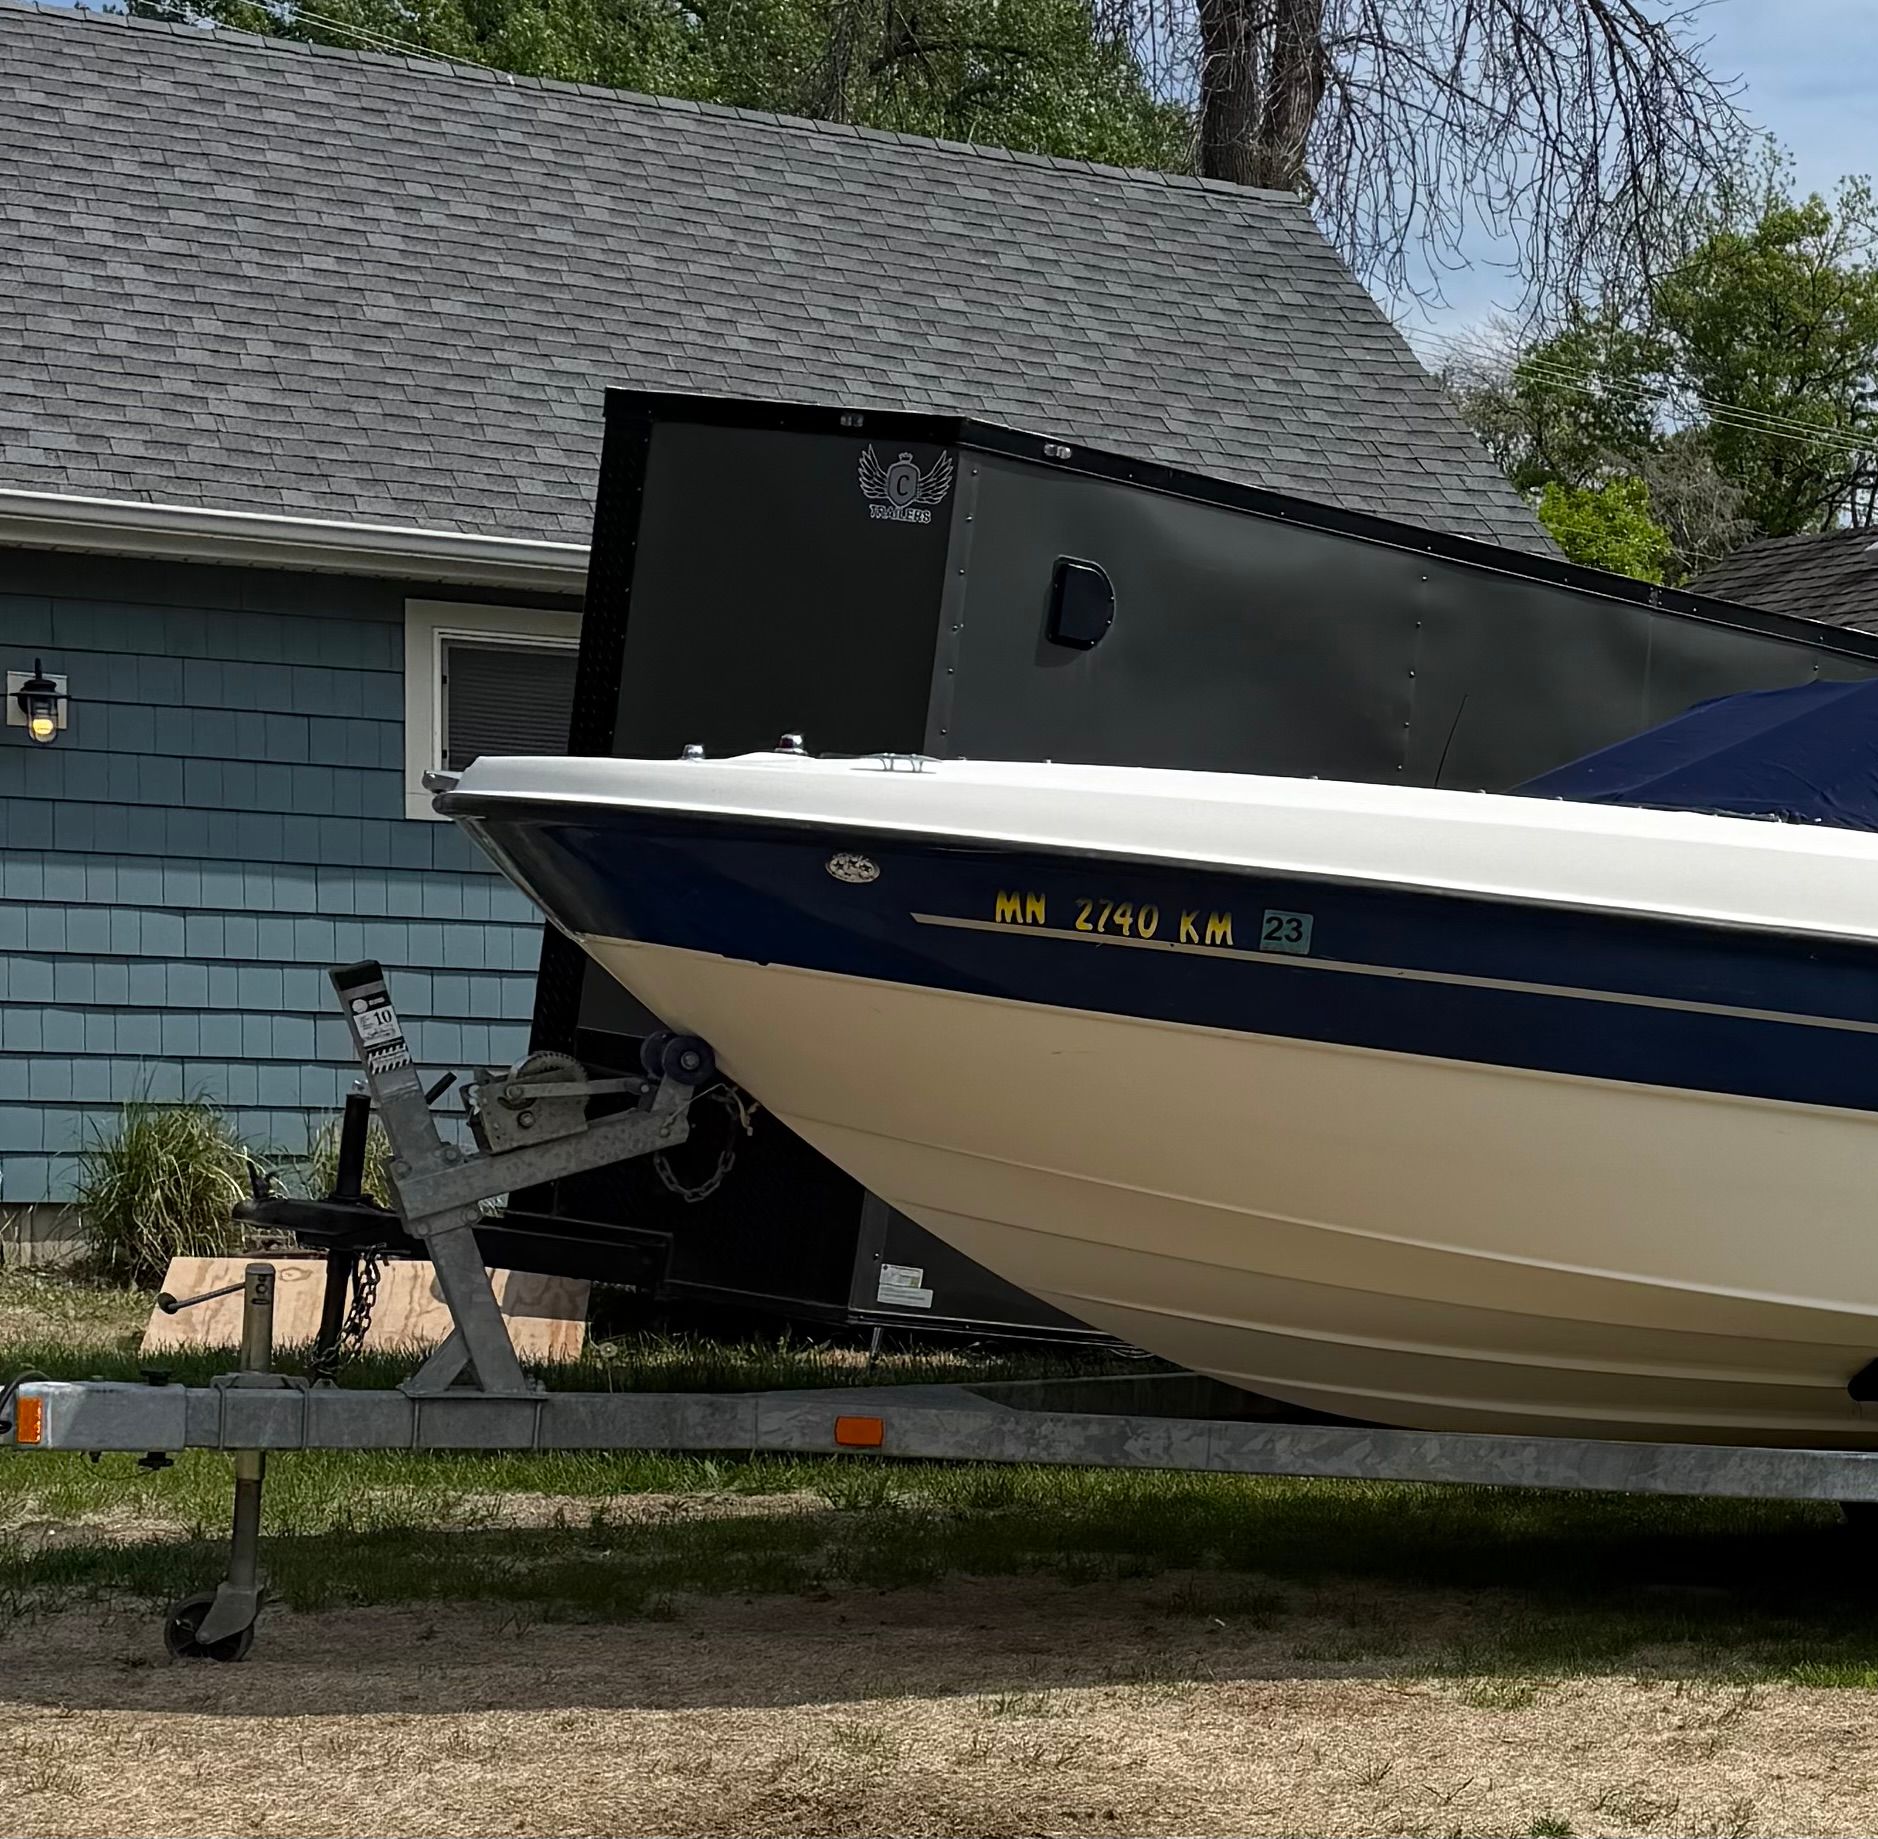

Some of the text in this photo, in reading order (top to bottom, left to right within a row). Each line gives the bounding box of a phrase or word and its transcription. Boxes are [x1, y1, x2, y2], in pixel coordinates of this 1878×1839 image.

[896, 474, 910, 496] C
[869, 504, 930, 522] TRAILERS
[996, 891, 1234, 946] MN 2740 KM
[1263, 916, 1303, 942] 23
[374, 1010, 391, 1024] 10
